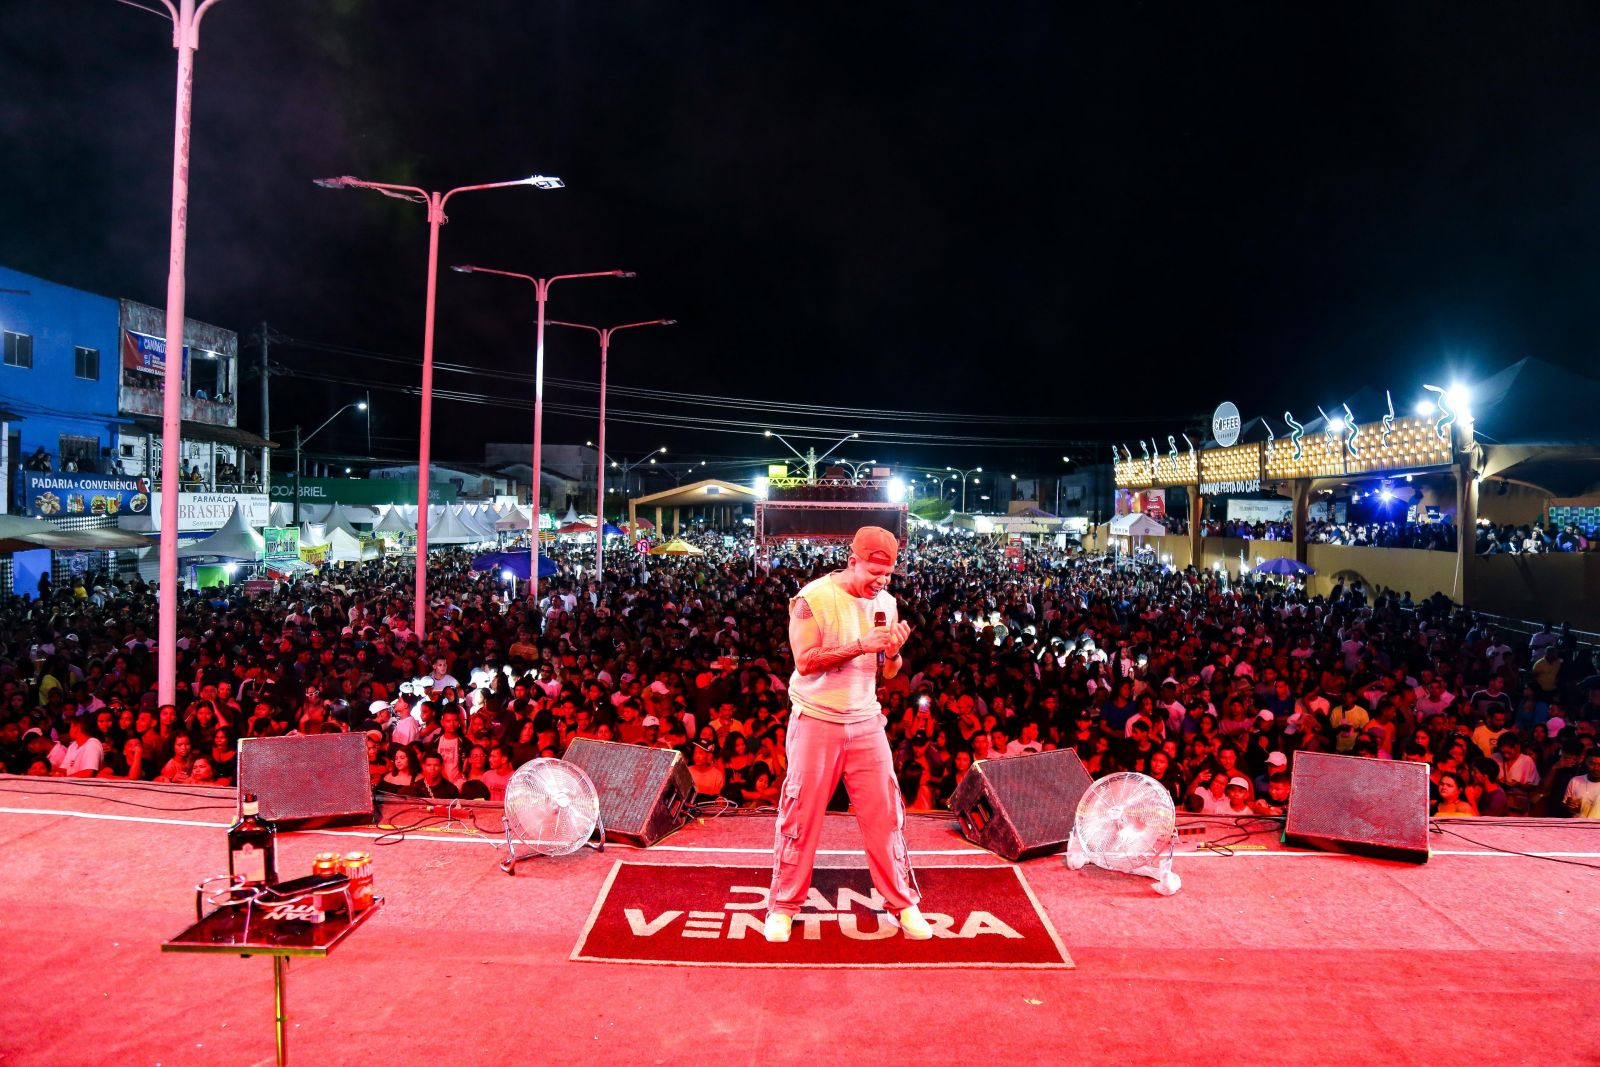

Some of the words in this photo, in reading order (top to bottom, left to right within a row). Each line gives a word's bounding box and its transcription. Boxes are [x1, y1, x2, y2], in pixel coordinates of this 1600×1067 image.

[31, 477, 74, 489] PADARIA
[80, 478, 138, 491] CONVENIÊNCIA
[724, 885, 888, 912] DAN
[624, 907, 1024, 940] VENTURA
